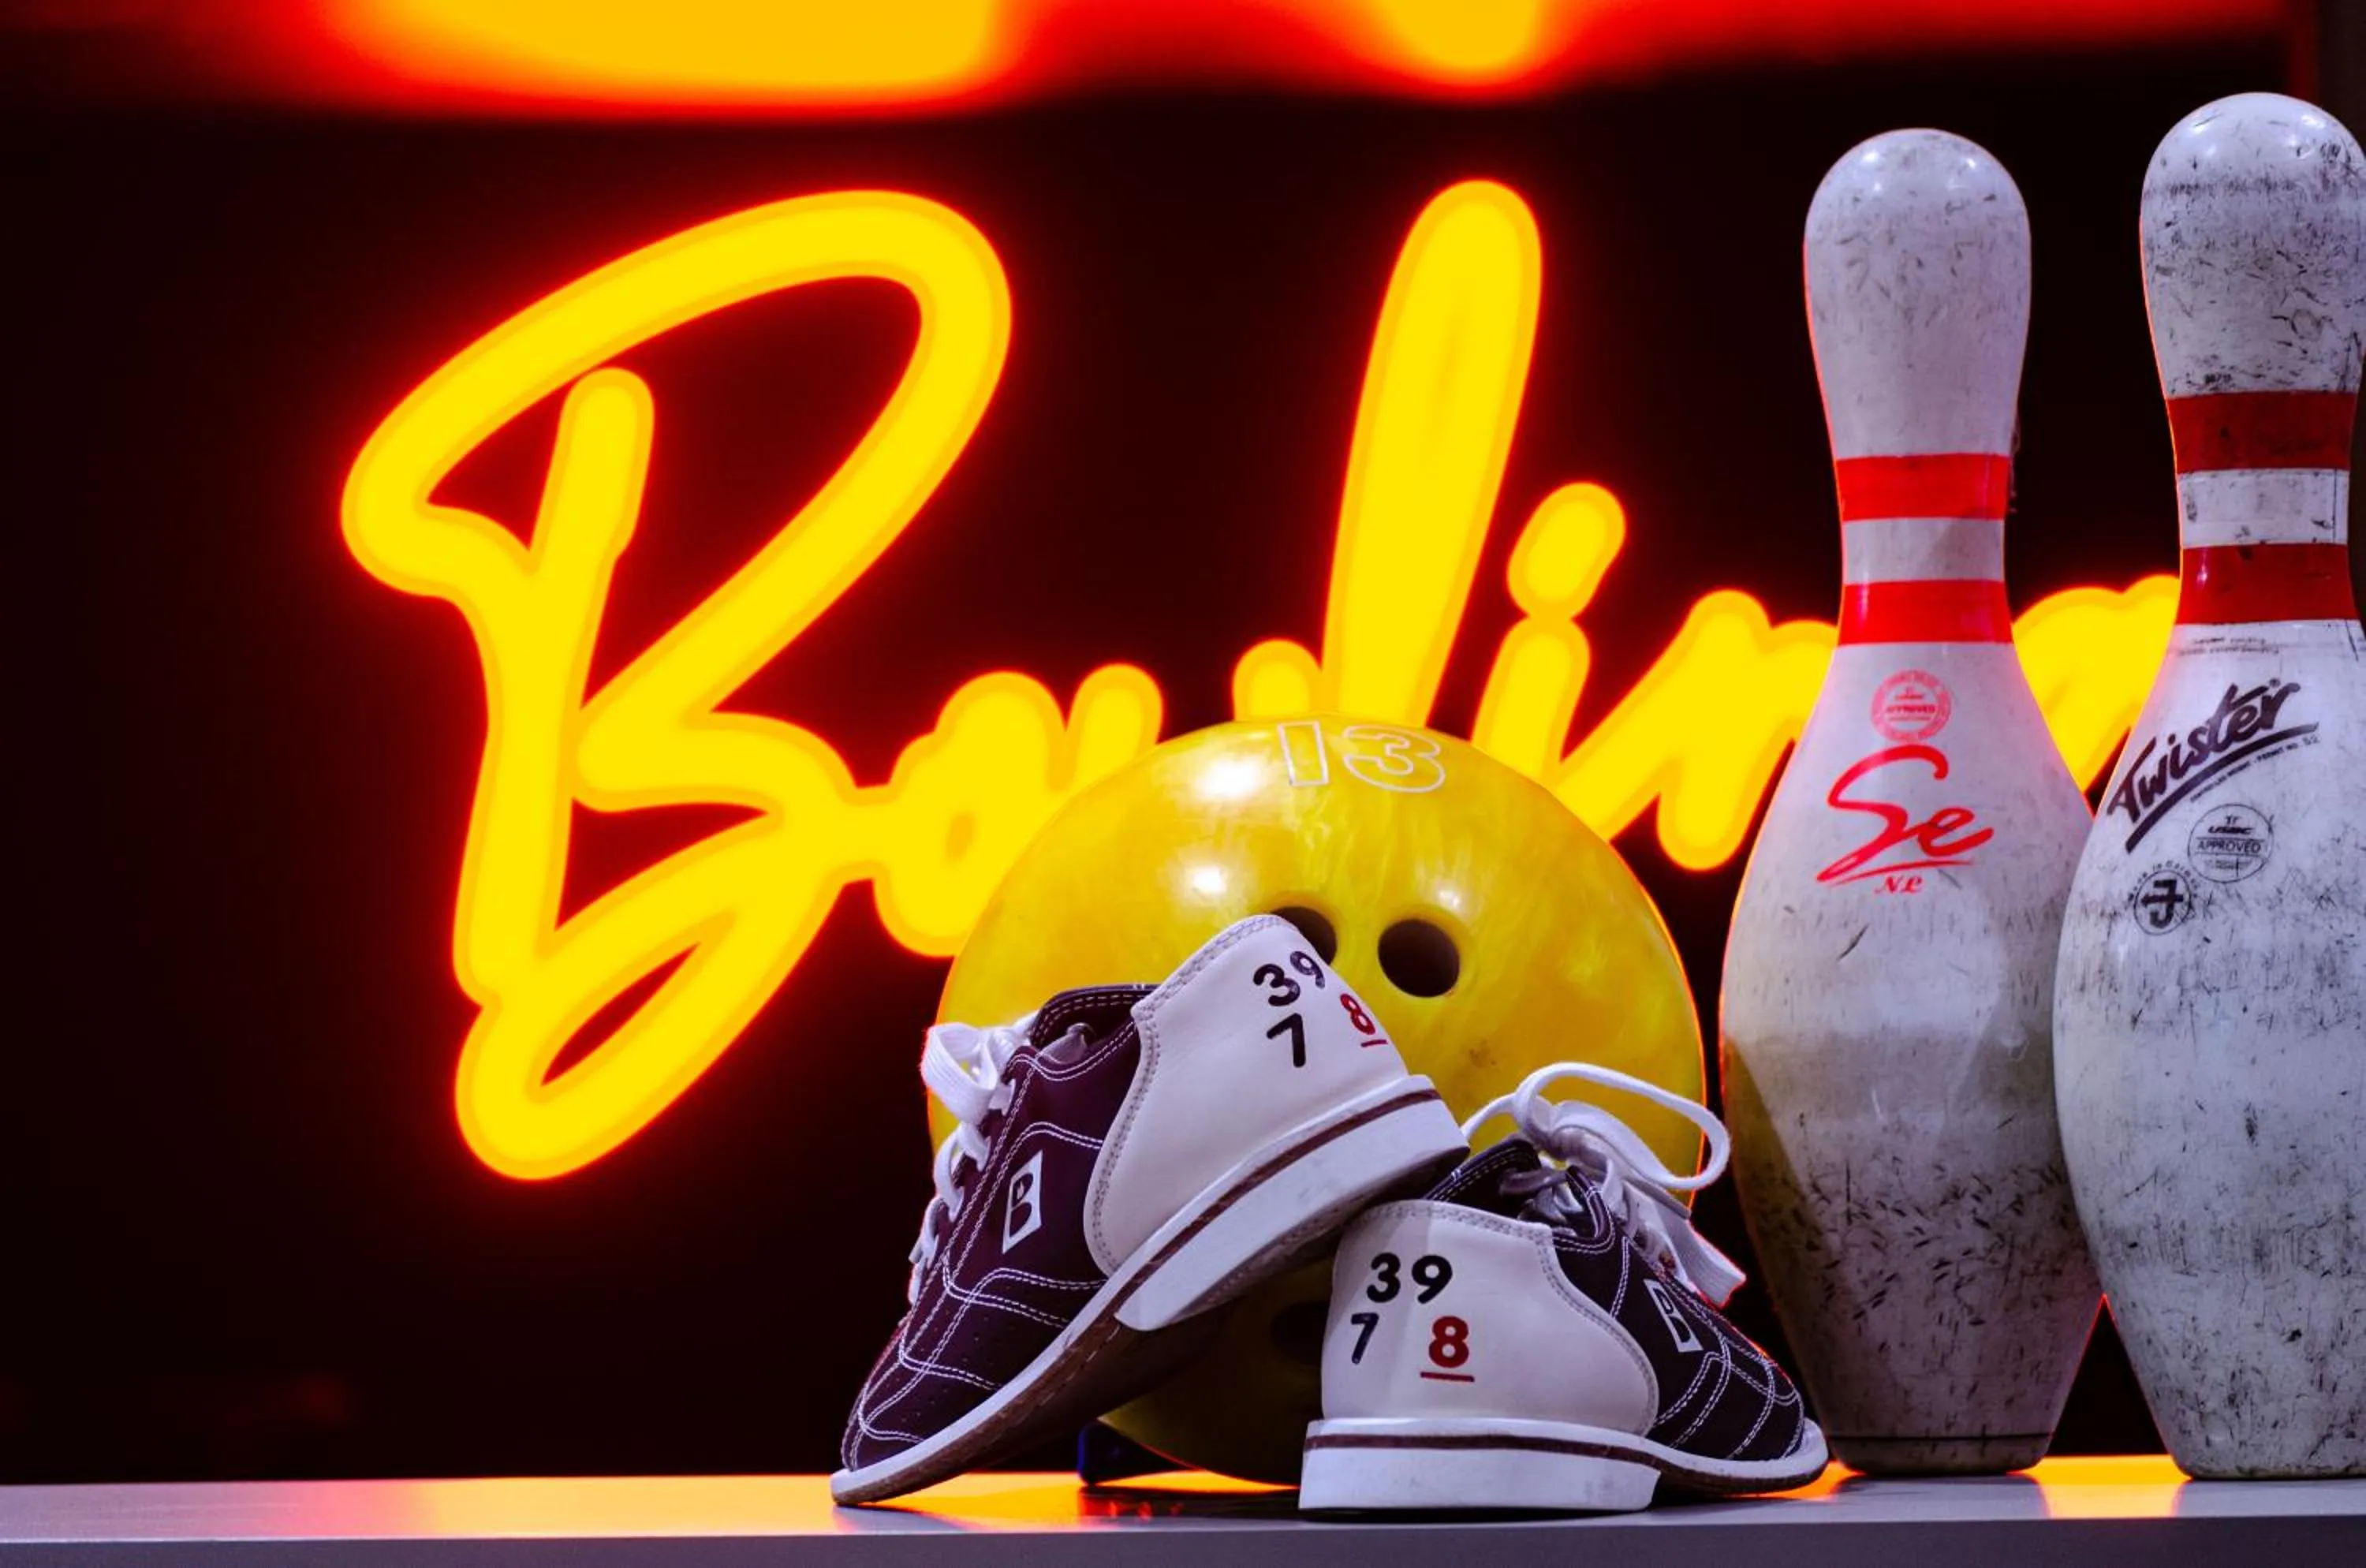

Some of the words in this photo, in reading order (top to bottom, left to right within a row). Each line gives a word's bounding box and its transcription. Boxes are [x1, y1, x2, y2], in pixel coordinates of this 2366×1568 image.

[1277, 720, 1446, 793] 13
[2107, 682, 2301, 823] Twister
[1817, 744, 1994, 883] Se
[2196, 838, 2262, 854] APPROVED
[1252, 950, 1326, 1006] 39
[1266, 1013, 1306, 1068] 7
[1339, 993, 1375, 1036] 8
[1366, 1252, 1453, 1305] 39
[1350, 1312, 1379, 1365] 7
[1428, 1316, 1469, 1368] 8
